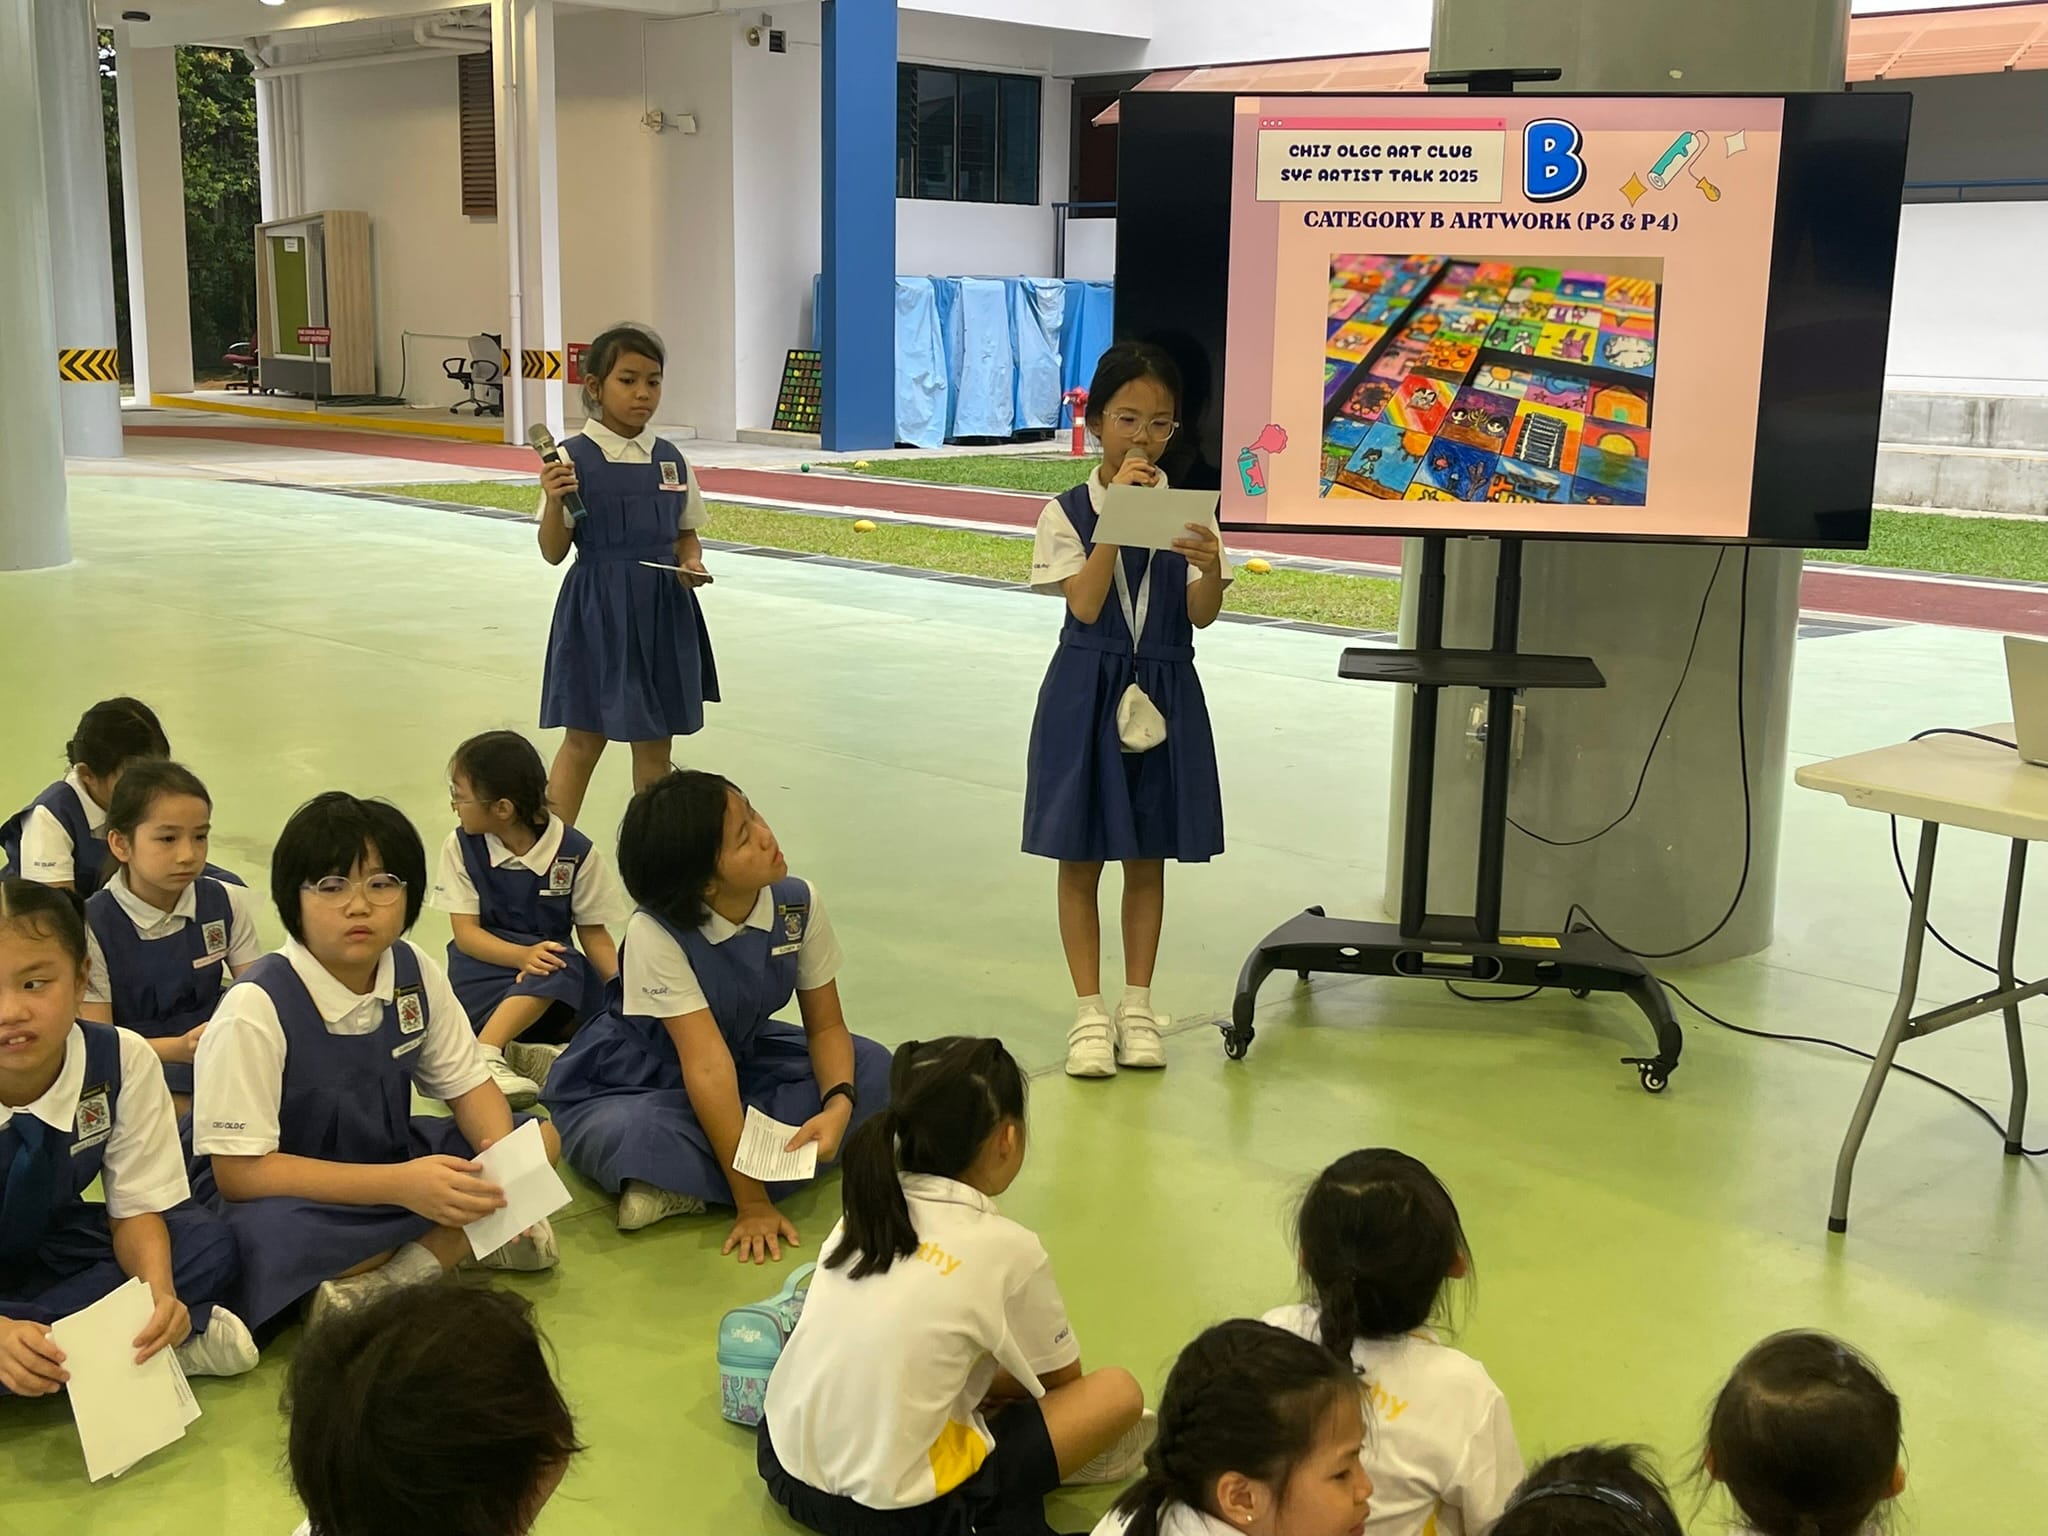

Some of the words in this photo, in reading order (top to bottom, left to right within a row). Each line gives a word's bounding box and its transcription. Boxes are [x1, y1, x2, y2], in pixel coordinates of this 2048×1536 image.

[1288, 144, 1332, 158] CHIJ
[1336, 144, 1382, 158] OLGC
[1386, 144, 1423, 159] ART
[1427, 145, 1473, 159] CLUB
[1522, 118, 1587, 203] B
[1280, 168, 1313, 182] SYF
[1317, 168, 1384, 182] ARTIST
[1388, 169, 1434, 183] TALK
[1438, 169, 1479, 183] 2025
[1303, 210, 1426, 229] CATEGORY
[1429, 211, 1445, 229] B
[1449, 211, 1572, 230] ARTWORK
[1577, 211, 1615, 231] (P3
[1619, 213, 1637, 231] &
[1640, 212, 1679, 232] P4)
[917, 1242, 961, 1275] thy
